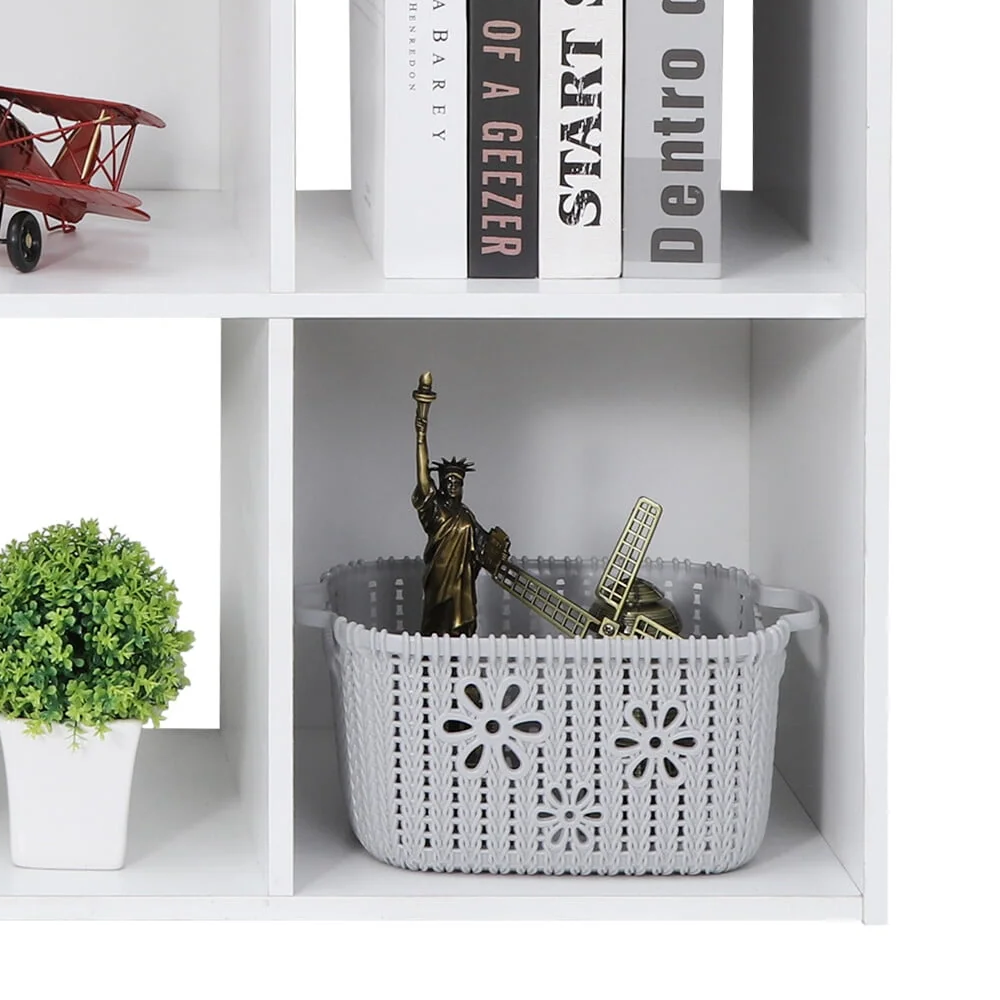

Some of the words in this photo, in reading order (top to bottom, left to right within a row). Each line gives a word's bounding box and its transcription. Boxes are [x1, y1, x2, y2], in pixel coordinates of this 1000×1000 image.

[482, 20, 523, 62] OF
[482, 81, 521, 99] A
[481, 121, 525, 257] GEEZER
[557, 27, 604, 228] START
[650, 48, 706, 264] Dentro
